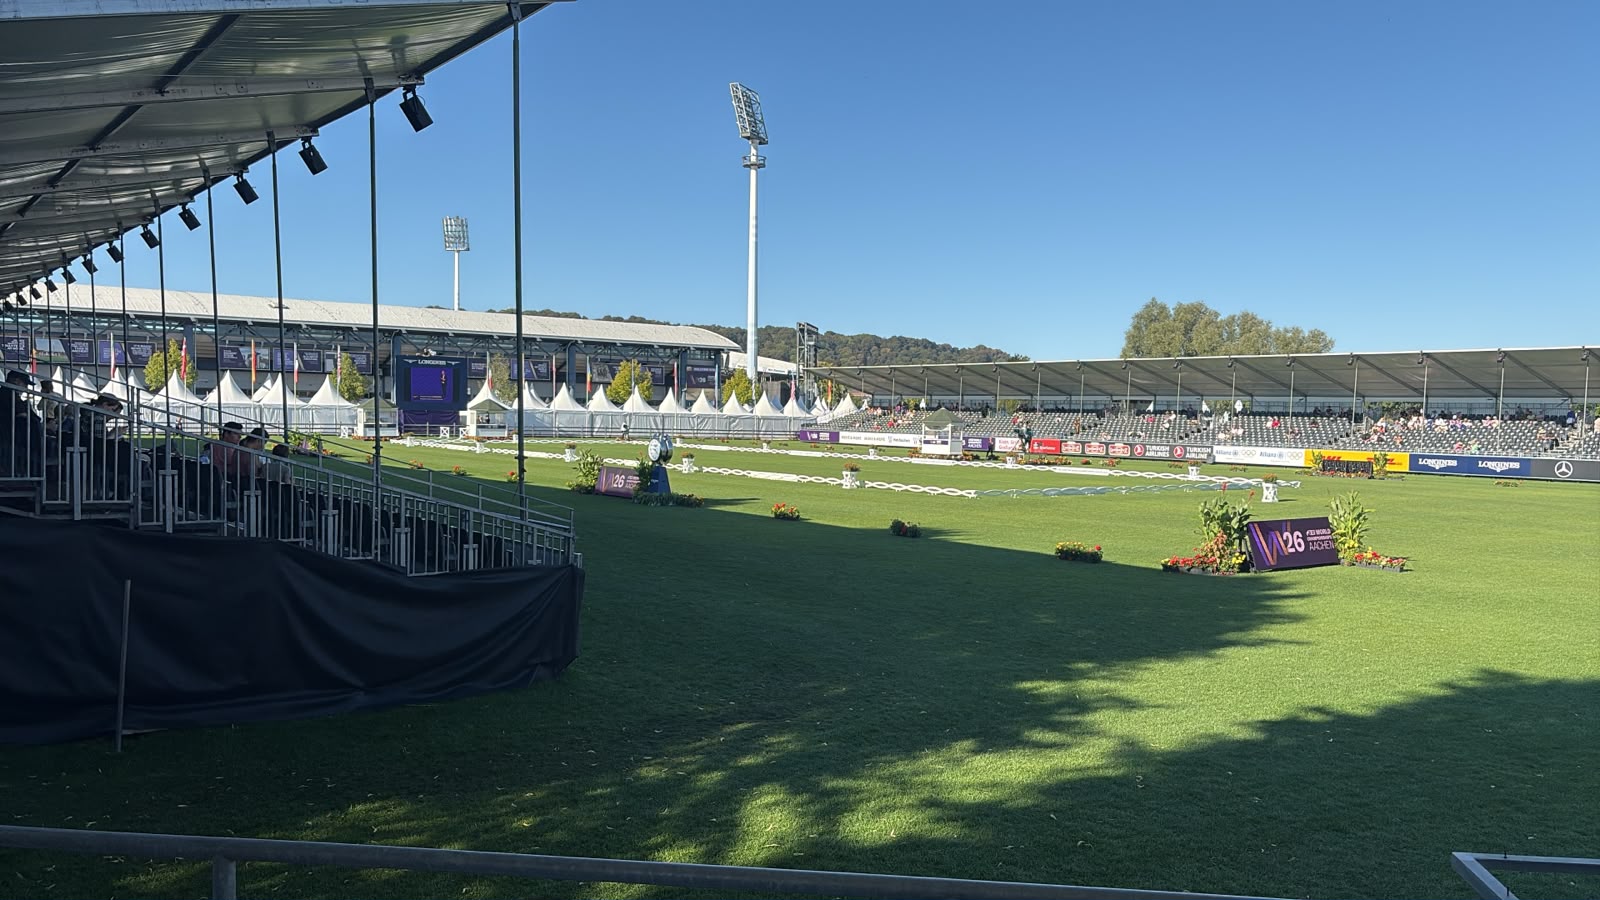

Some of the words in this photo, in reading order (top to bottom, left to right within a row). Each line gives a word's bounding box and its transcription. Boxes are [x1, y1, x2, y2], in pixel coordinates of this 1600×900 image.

[1418, 458, 1458, 467] LONGINES
[1478, 460, 1521, 469] LONGINES
[613, 474, 625, 488] 26
[1283, 530, 1305, 553] 26
[1309, 540, 1335, 551] AACHEN
